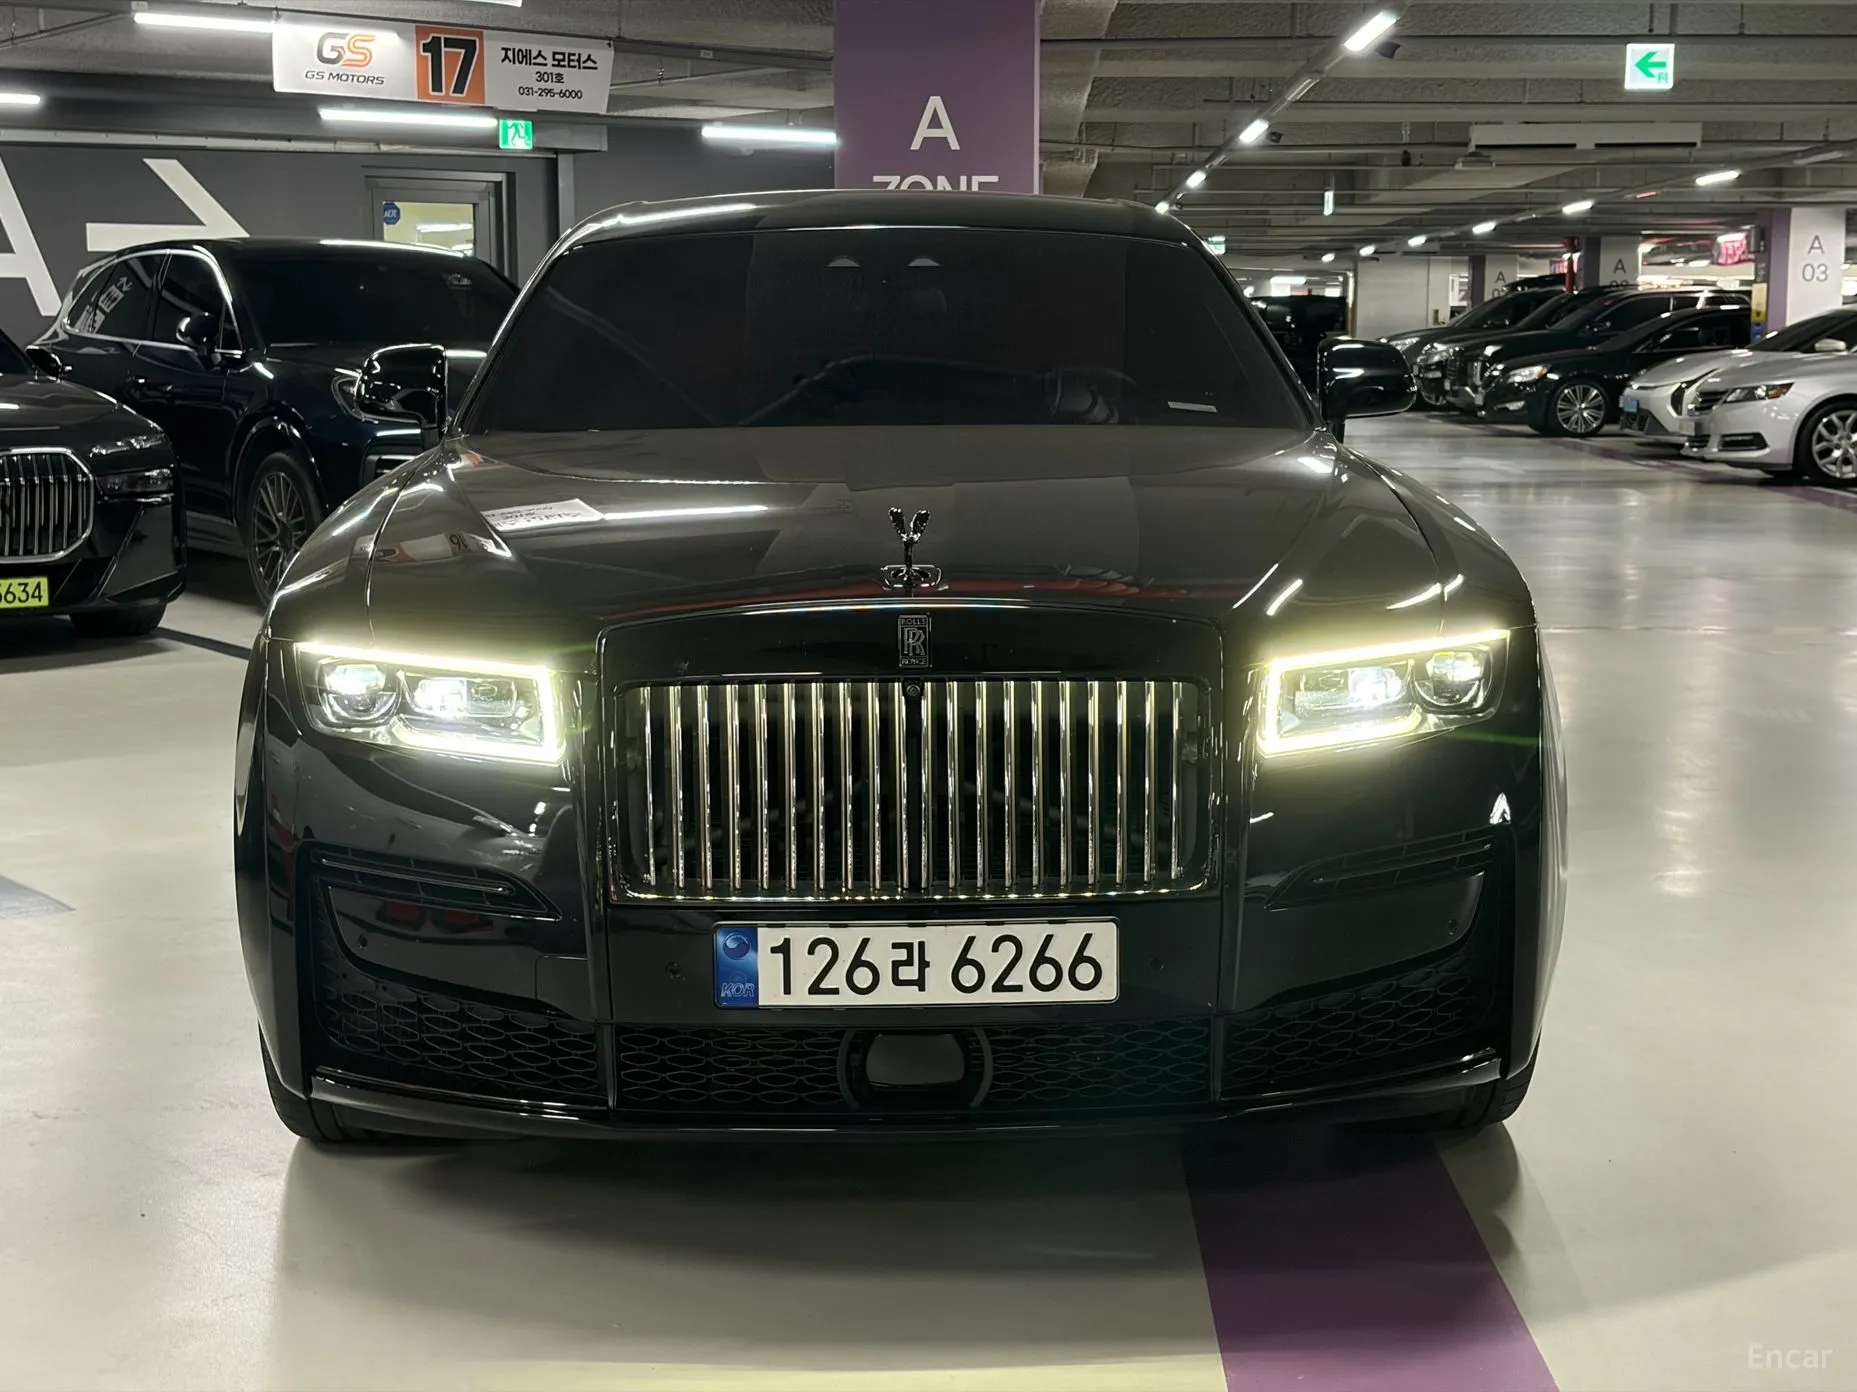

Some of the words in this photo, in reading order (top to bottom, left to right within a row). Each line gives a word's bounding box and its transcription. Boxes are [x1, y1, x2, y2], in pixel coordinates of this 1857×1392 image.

[316, 31, 376, 68] GS
[501, 46, 548, 67] 지에스
[551, 51, 598, 70] 모터스
[420, 33, 479, 96] 17
[304, 70, 325, 80] GS
[327, 72, 385, 85] MOTORS
[535, 71, 564, 84] 301호
[518, 86, 583, 100] 031-295-6000
[910, 95, 961, 150] A
[1807, 235, 1825, 254] A
[1613, 259, 1626, 274] A
[1802, 263, 1828, 282] 03
[1494, 271, 1507, 284] A
[0, 580, 43, 604] 634
[769, 937, 930, 996] 126라
[950, 932, 1103, 995] 6266
[720, 982, 756, 998] KOR
